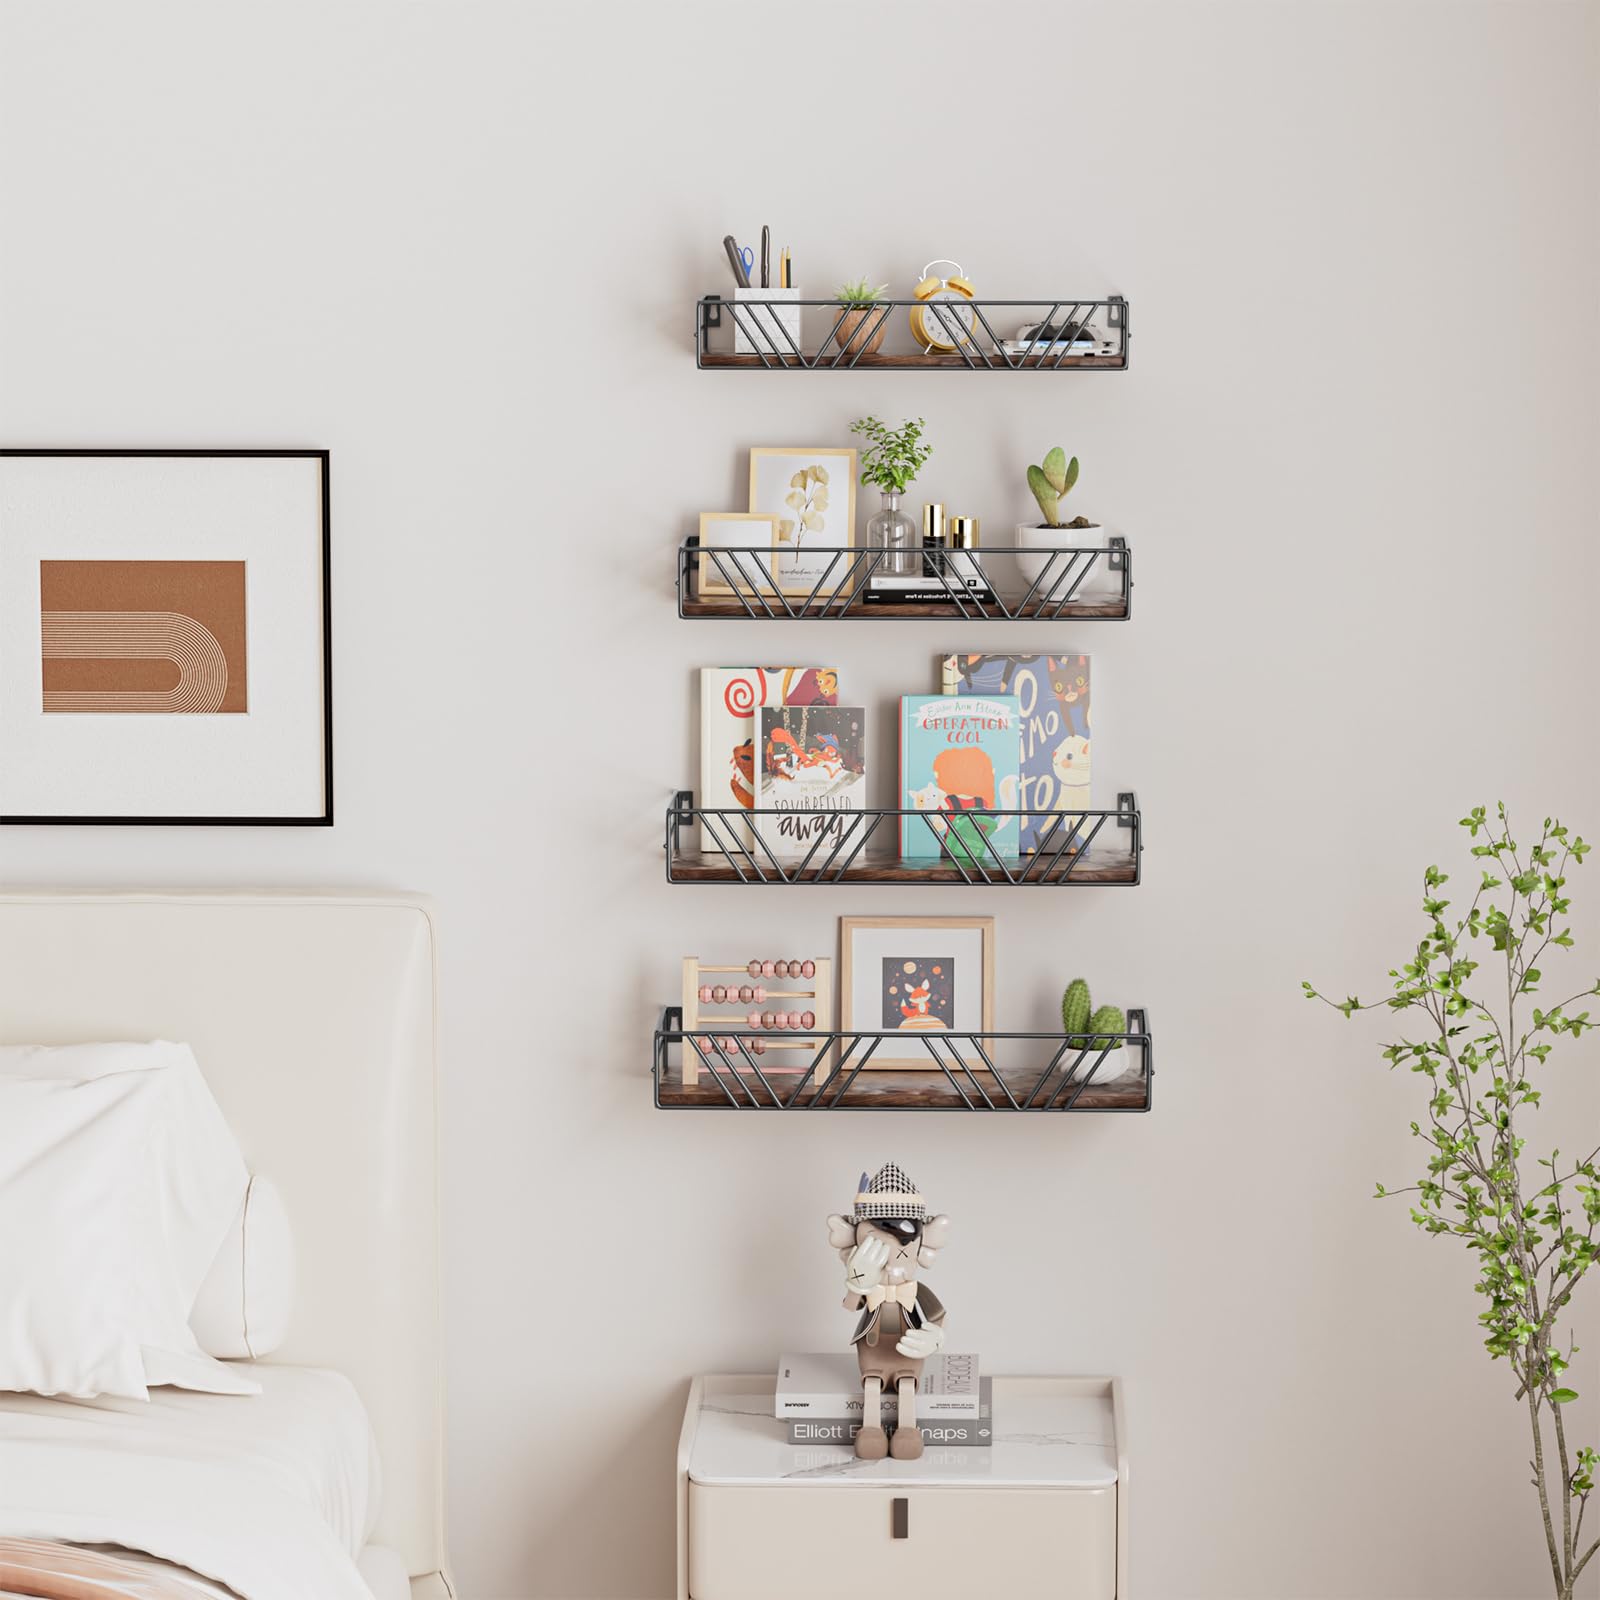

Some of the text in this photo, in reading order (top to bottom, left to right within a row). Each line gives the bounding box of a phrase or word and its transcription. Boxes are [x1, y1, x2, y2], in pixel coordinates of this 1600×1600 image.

[922, 717, 1009, 730] OPERATION
[947, 731, 984, 744] COOL
[777, 815, 845, 850] away
[794, 1424, 843, 1439] Elliott
